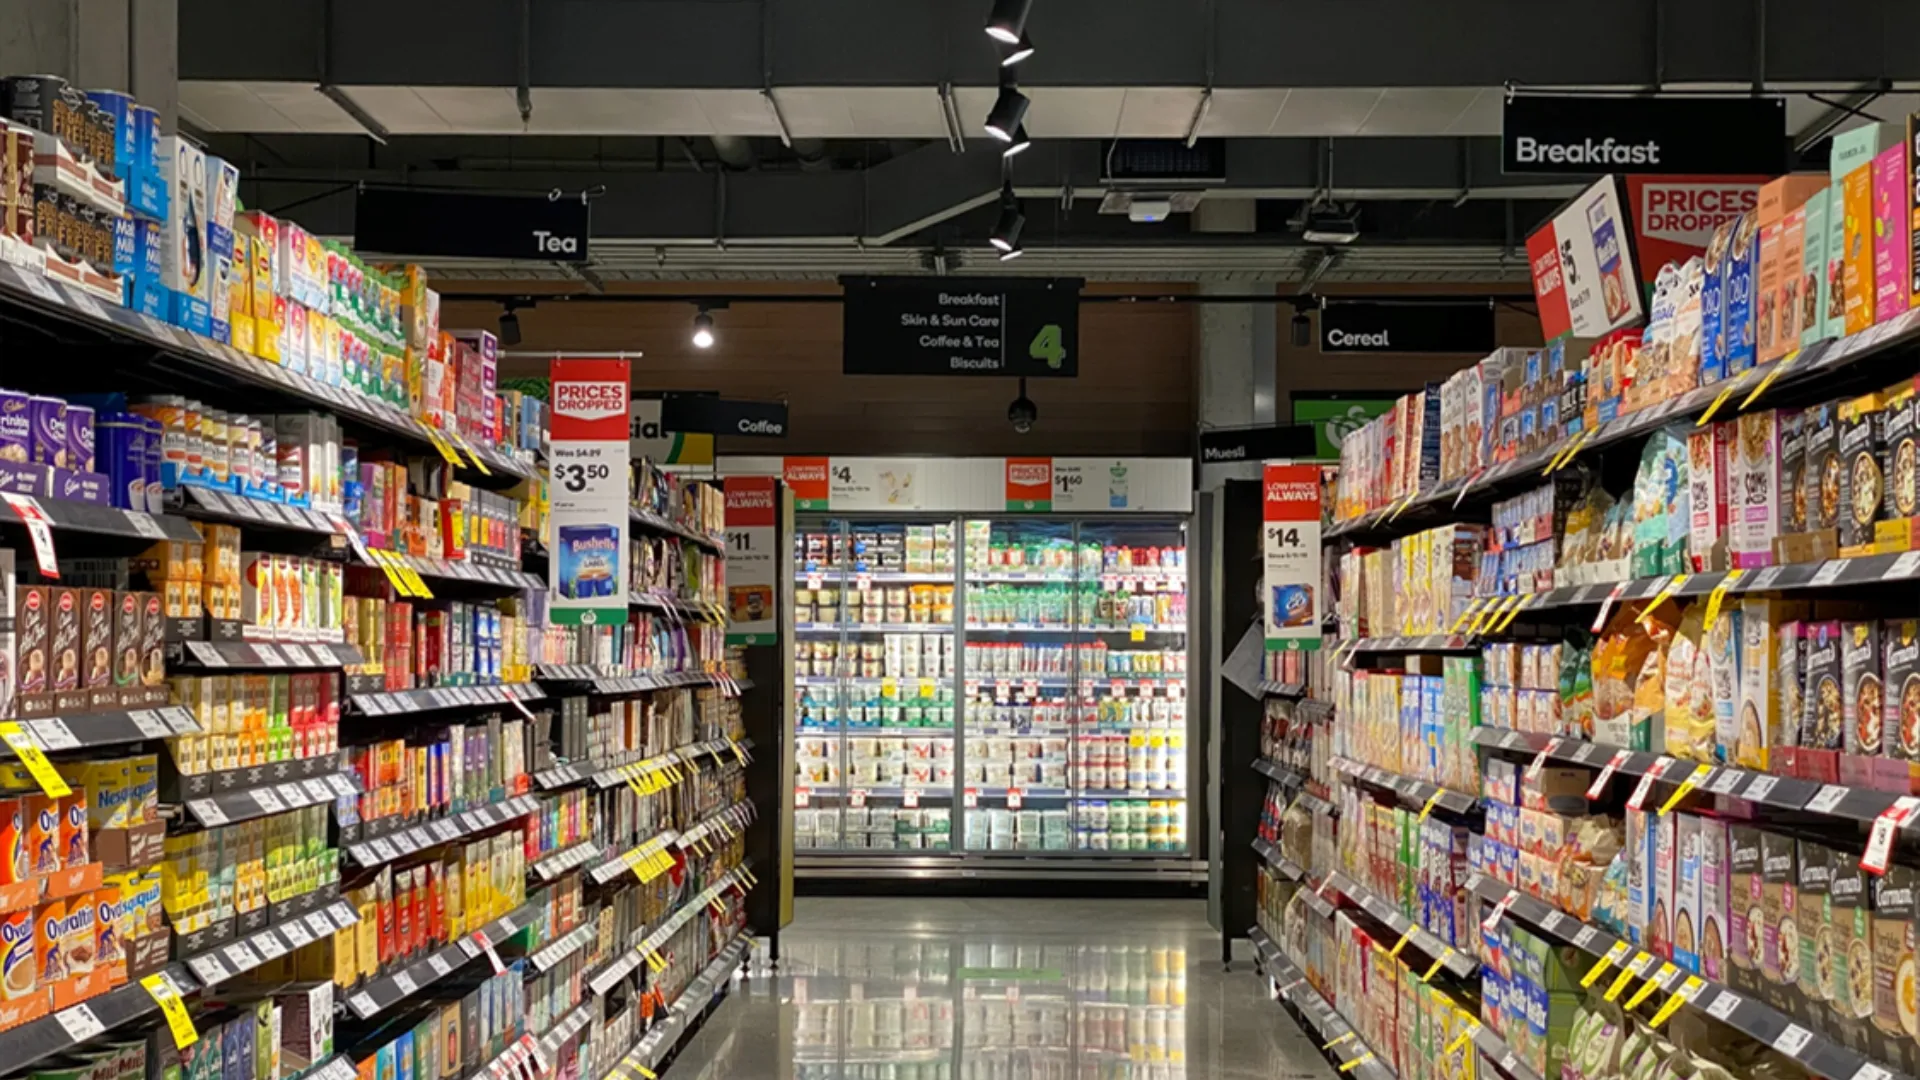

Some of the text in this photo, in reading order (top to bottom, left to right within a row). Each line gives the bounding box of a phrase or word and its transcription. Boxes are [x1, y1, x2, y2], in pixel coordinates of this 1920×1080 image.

[1516, 137, 1660, 164] Breakfast
[1648, 190, 1758, 213] PRICES
[533, 231, 577, 253] Tea
[938, 293, 999, 306] Breakfast
[901, 314, 999, 327] Skin & Sun Care
[919, 335, 999, 348] Coffee & Tea
[1328, 329, 1390, 347] Cereal
[1029, 324, 1066, 369] 4
[950, 356, 999, 369] Biscuits
[557, 385, 622, 399] PRICES
[557, 399, 622, 411] DROPPED
[738, 418, 782, 434] Coffee
[1205, 446, 1245, 460] Muesli
[787, 472, 826, 481] ALWAYS
[832, 466, 851, 483] $4
[1267, 482, 1317, 490] LOW PRICE
[727, 491, 772, 499] LOW PRICE
[1267, 491, 1318, 501] ALWAYS
[727, 499, 773, 508] ALWAYS
[728, 532, 750, 550] $11
[1268, 528, 1300, 548] $14
